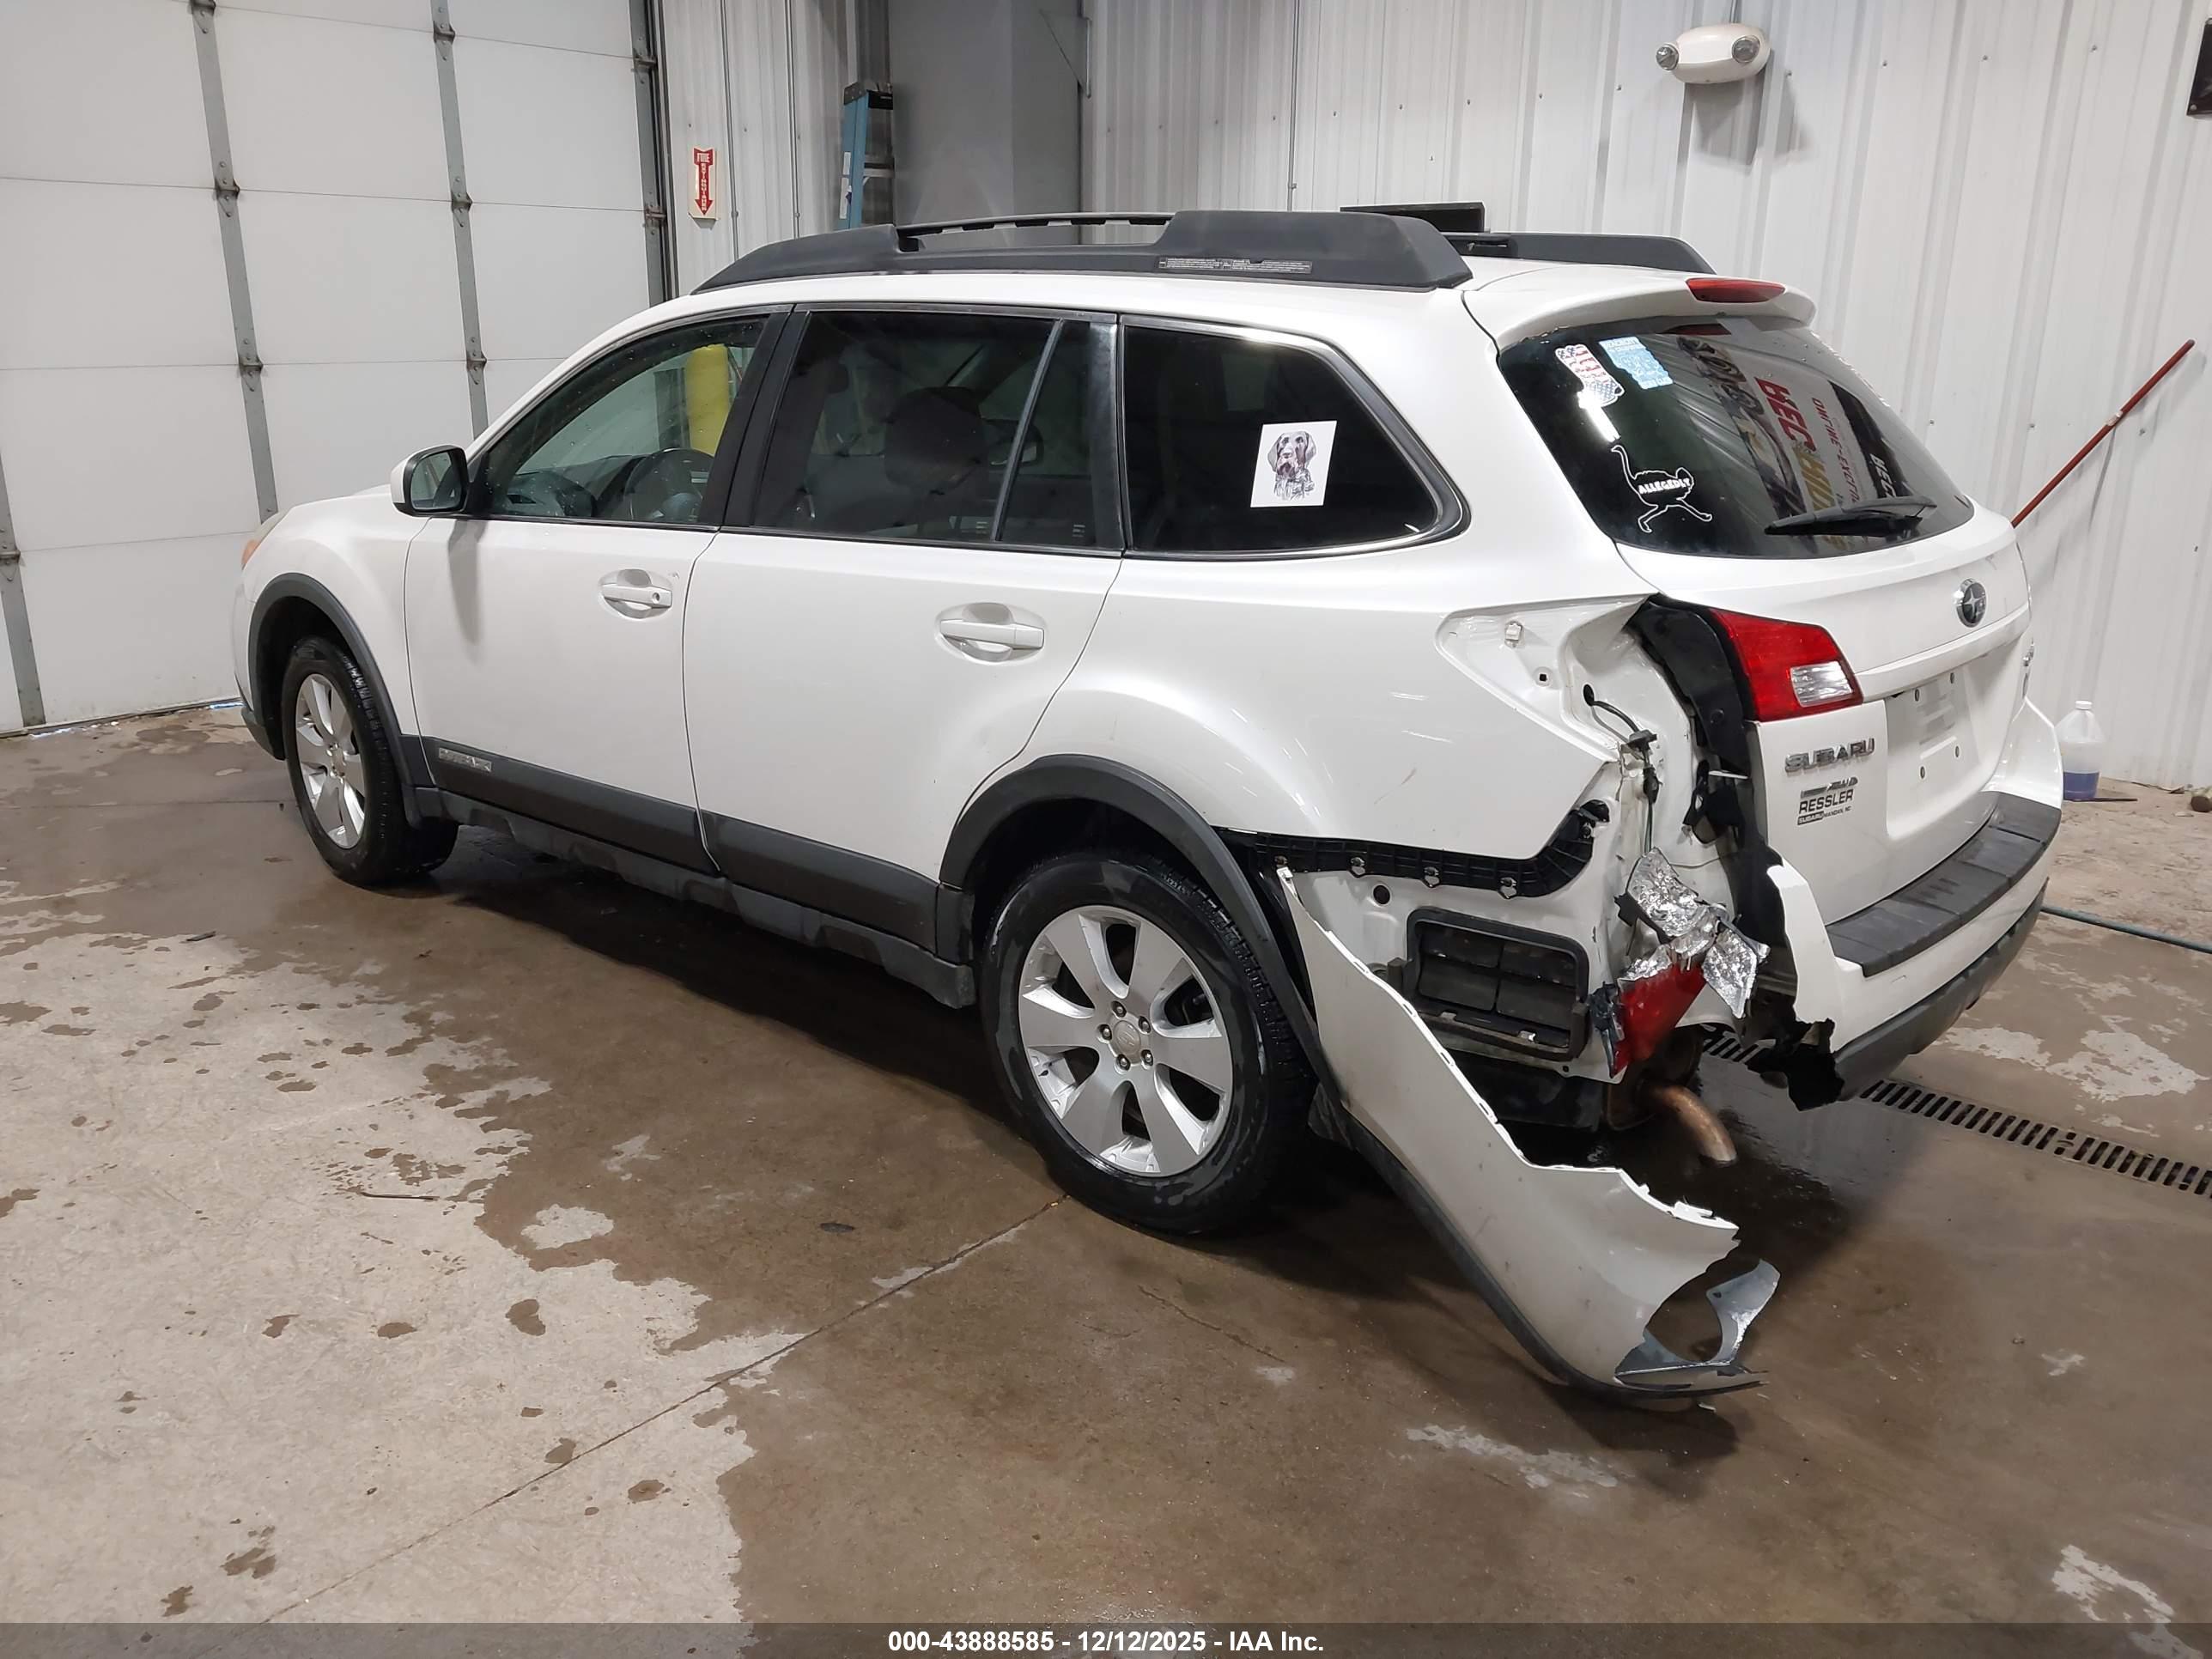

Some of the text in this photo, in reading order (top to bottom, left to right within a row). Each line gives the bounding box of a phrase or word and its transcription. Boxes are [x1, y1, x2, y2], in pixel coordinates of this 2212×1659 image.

[1638, 477, 1691, 495] ALLEGEDLY
[1785, 737, 1875, 773] SUBARU
[1799, 788, 1854, 815] RESSLER
